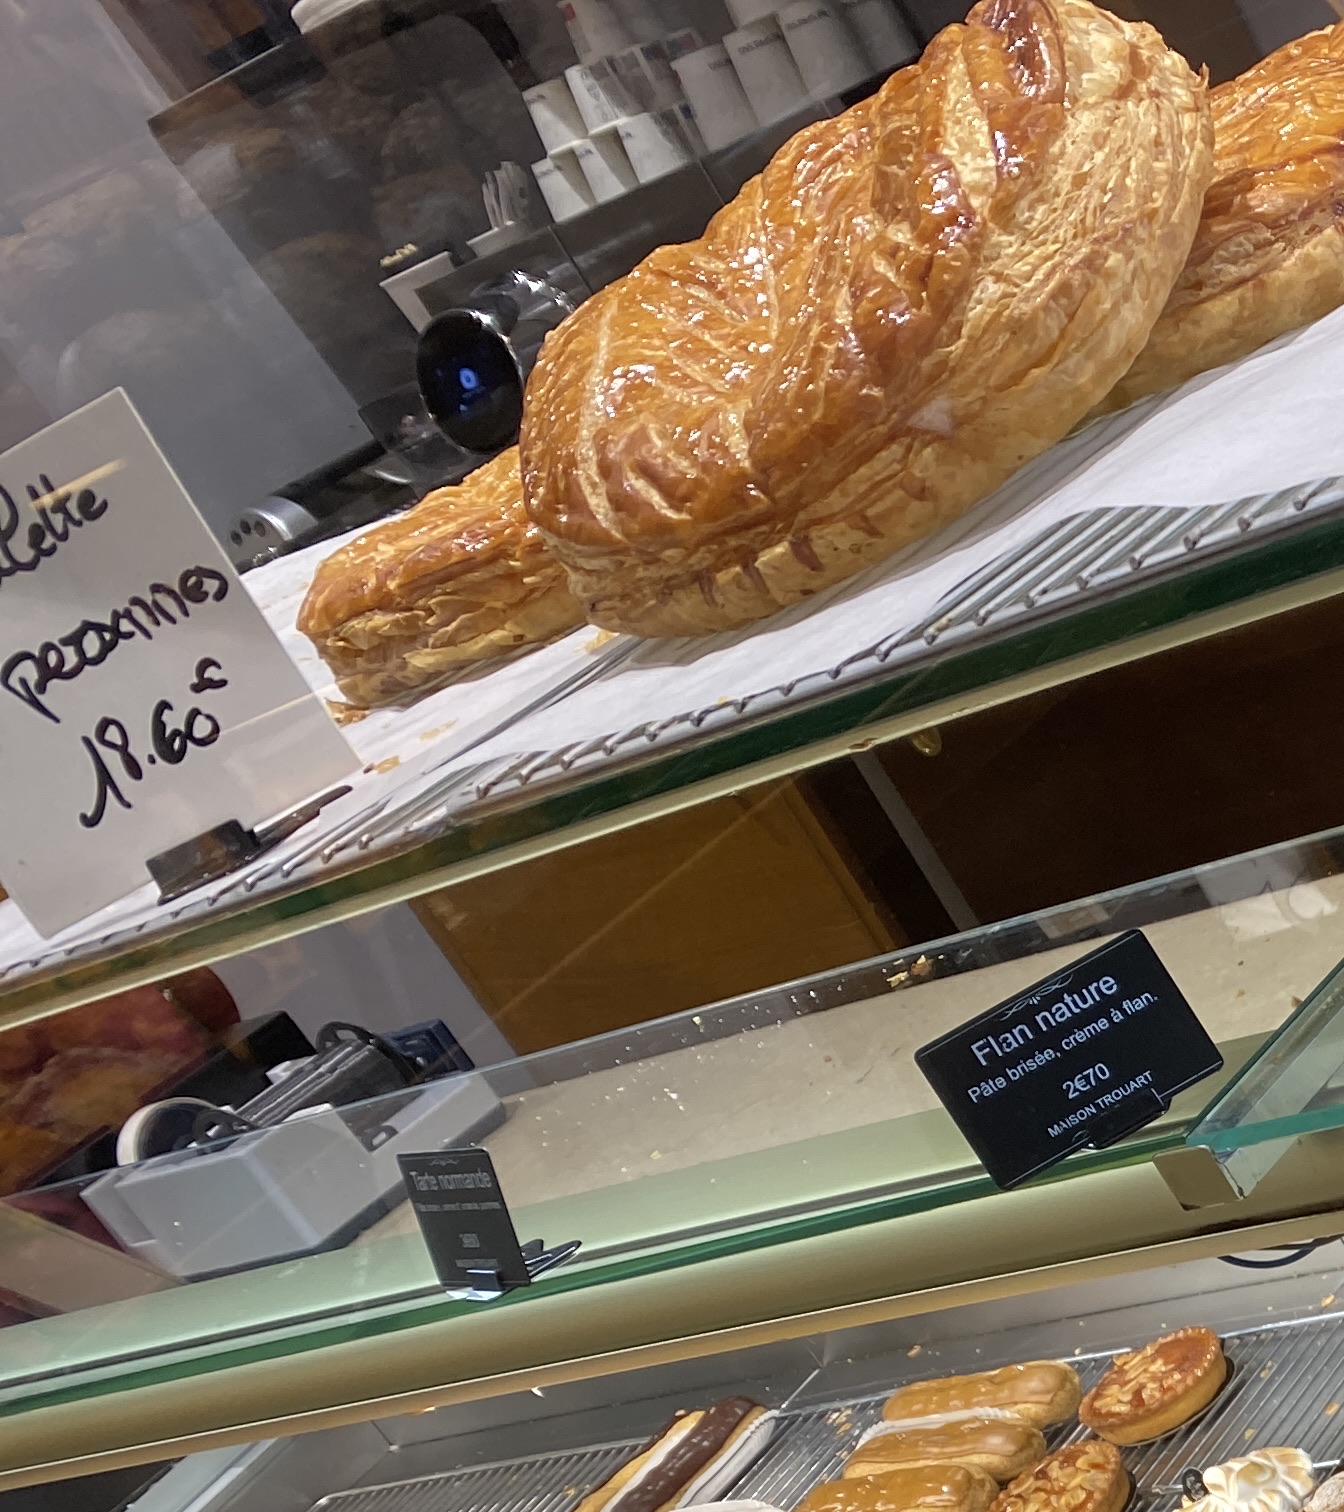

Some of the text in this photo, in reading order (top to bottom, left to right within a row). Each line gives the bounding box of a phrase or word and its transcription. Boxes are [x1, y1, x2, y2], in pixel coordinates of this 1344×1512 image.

[967, 991, 1158, 1104] Pâte brisée, crème à flan.
[971, 973, 1119, 1067] Flan nature
[1048, 1071, 1154, 1139] MAISON TROUART
[1063, 1062, 1111, 1100] 2€70
